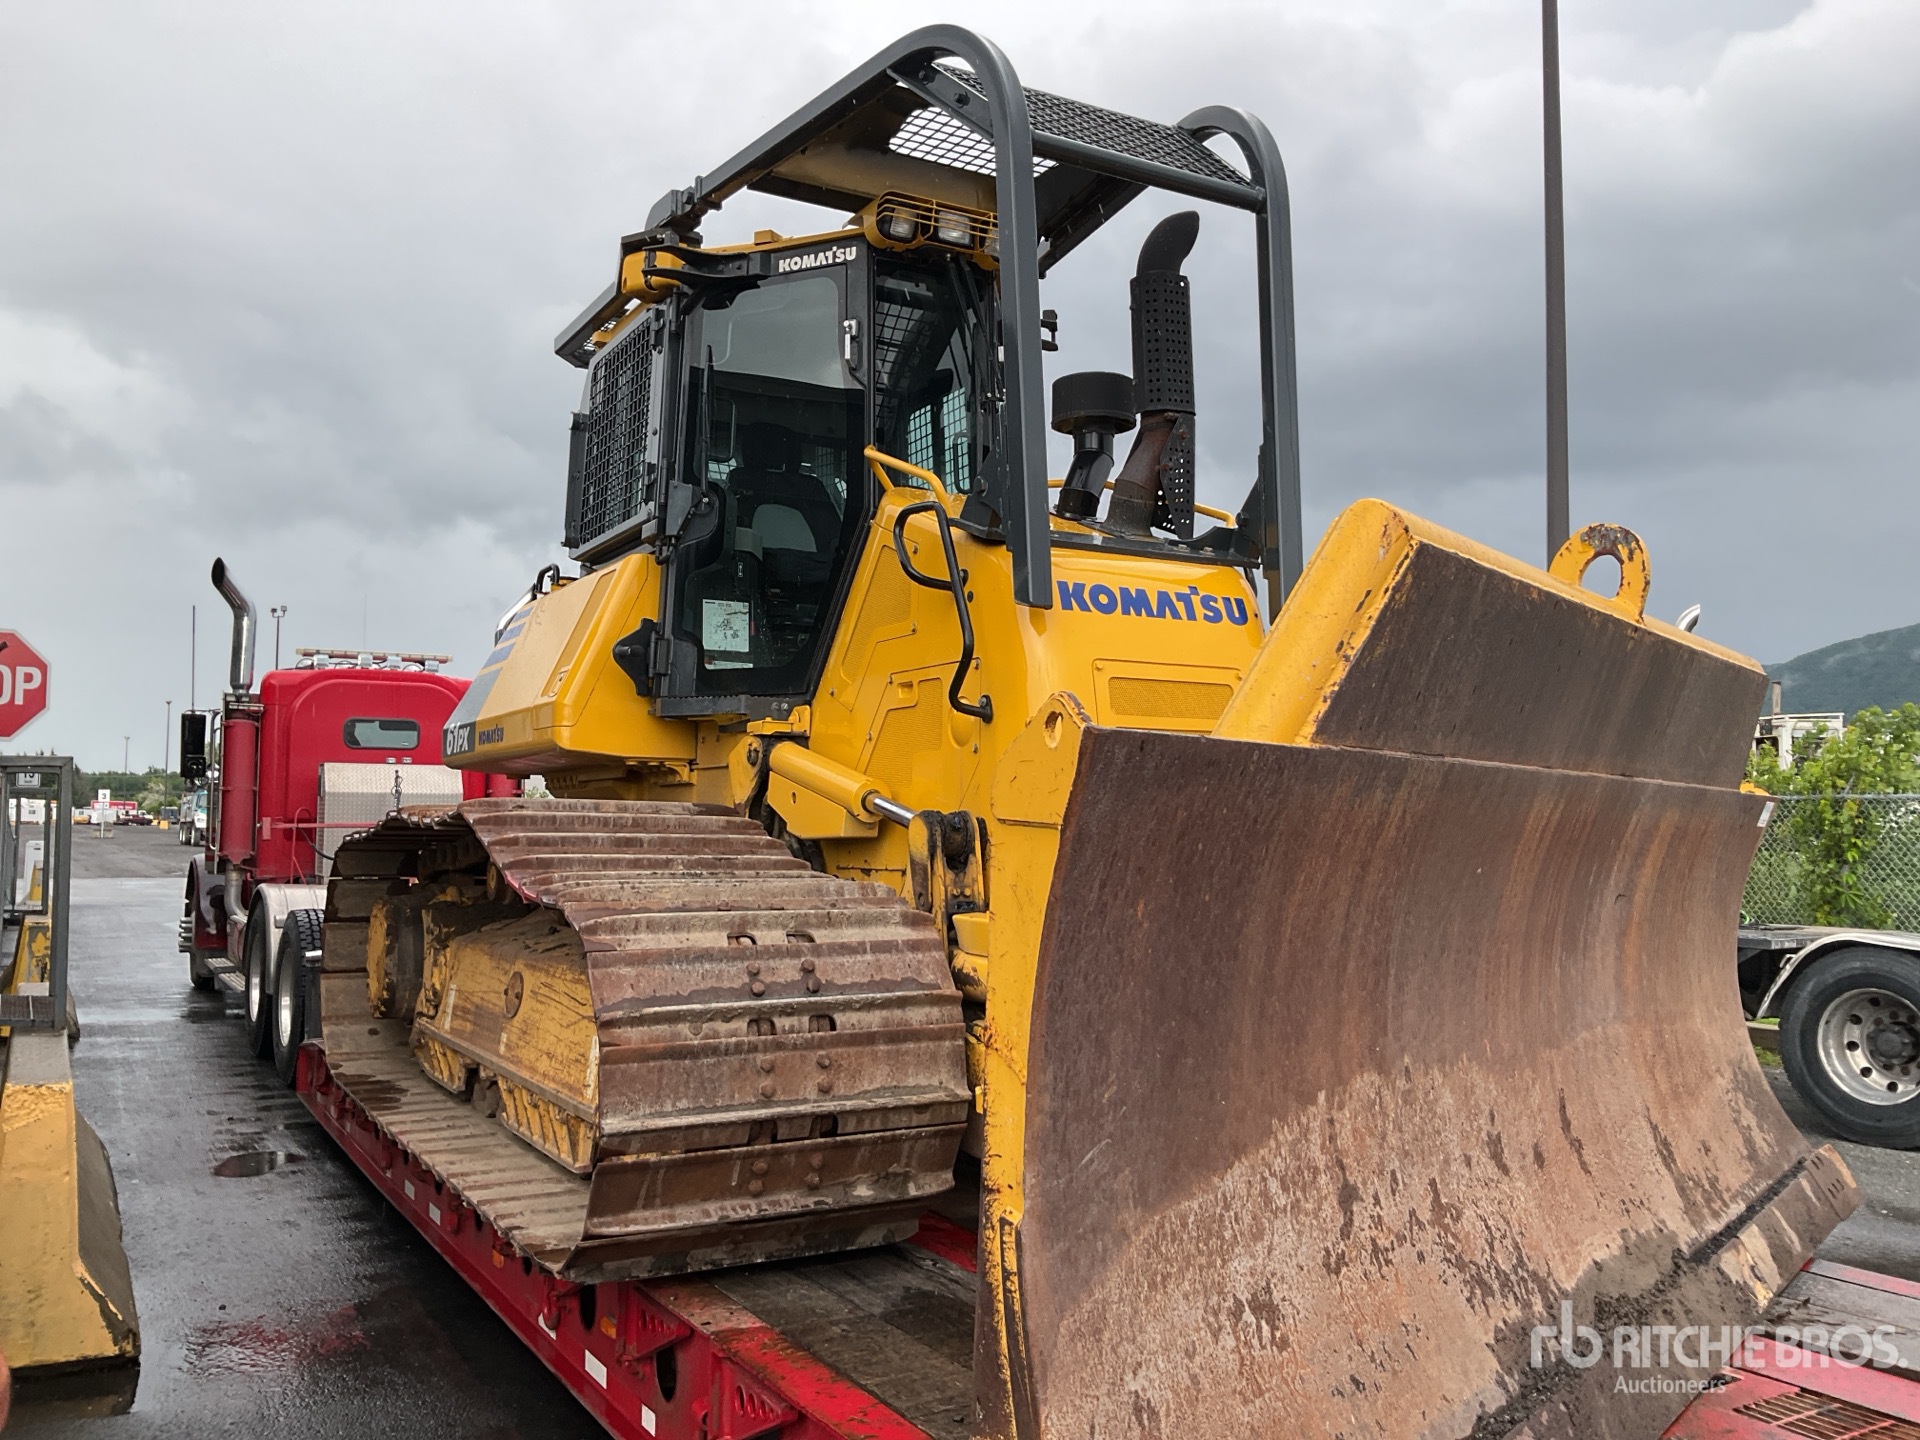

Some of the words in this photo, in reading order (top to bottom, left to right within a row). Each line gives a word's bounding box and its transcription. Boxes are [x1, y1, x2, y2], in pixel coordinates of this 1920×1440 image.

[778, 246, 857, 273] KOMATSU
[1056, 580, 1249, 627] KOMATSU
[446, 721, 471, 756] 61PX
[101, 792, 107, 800] 3
